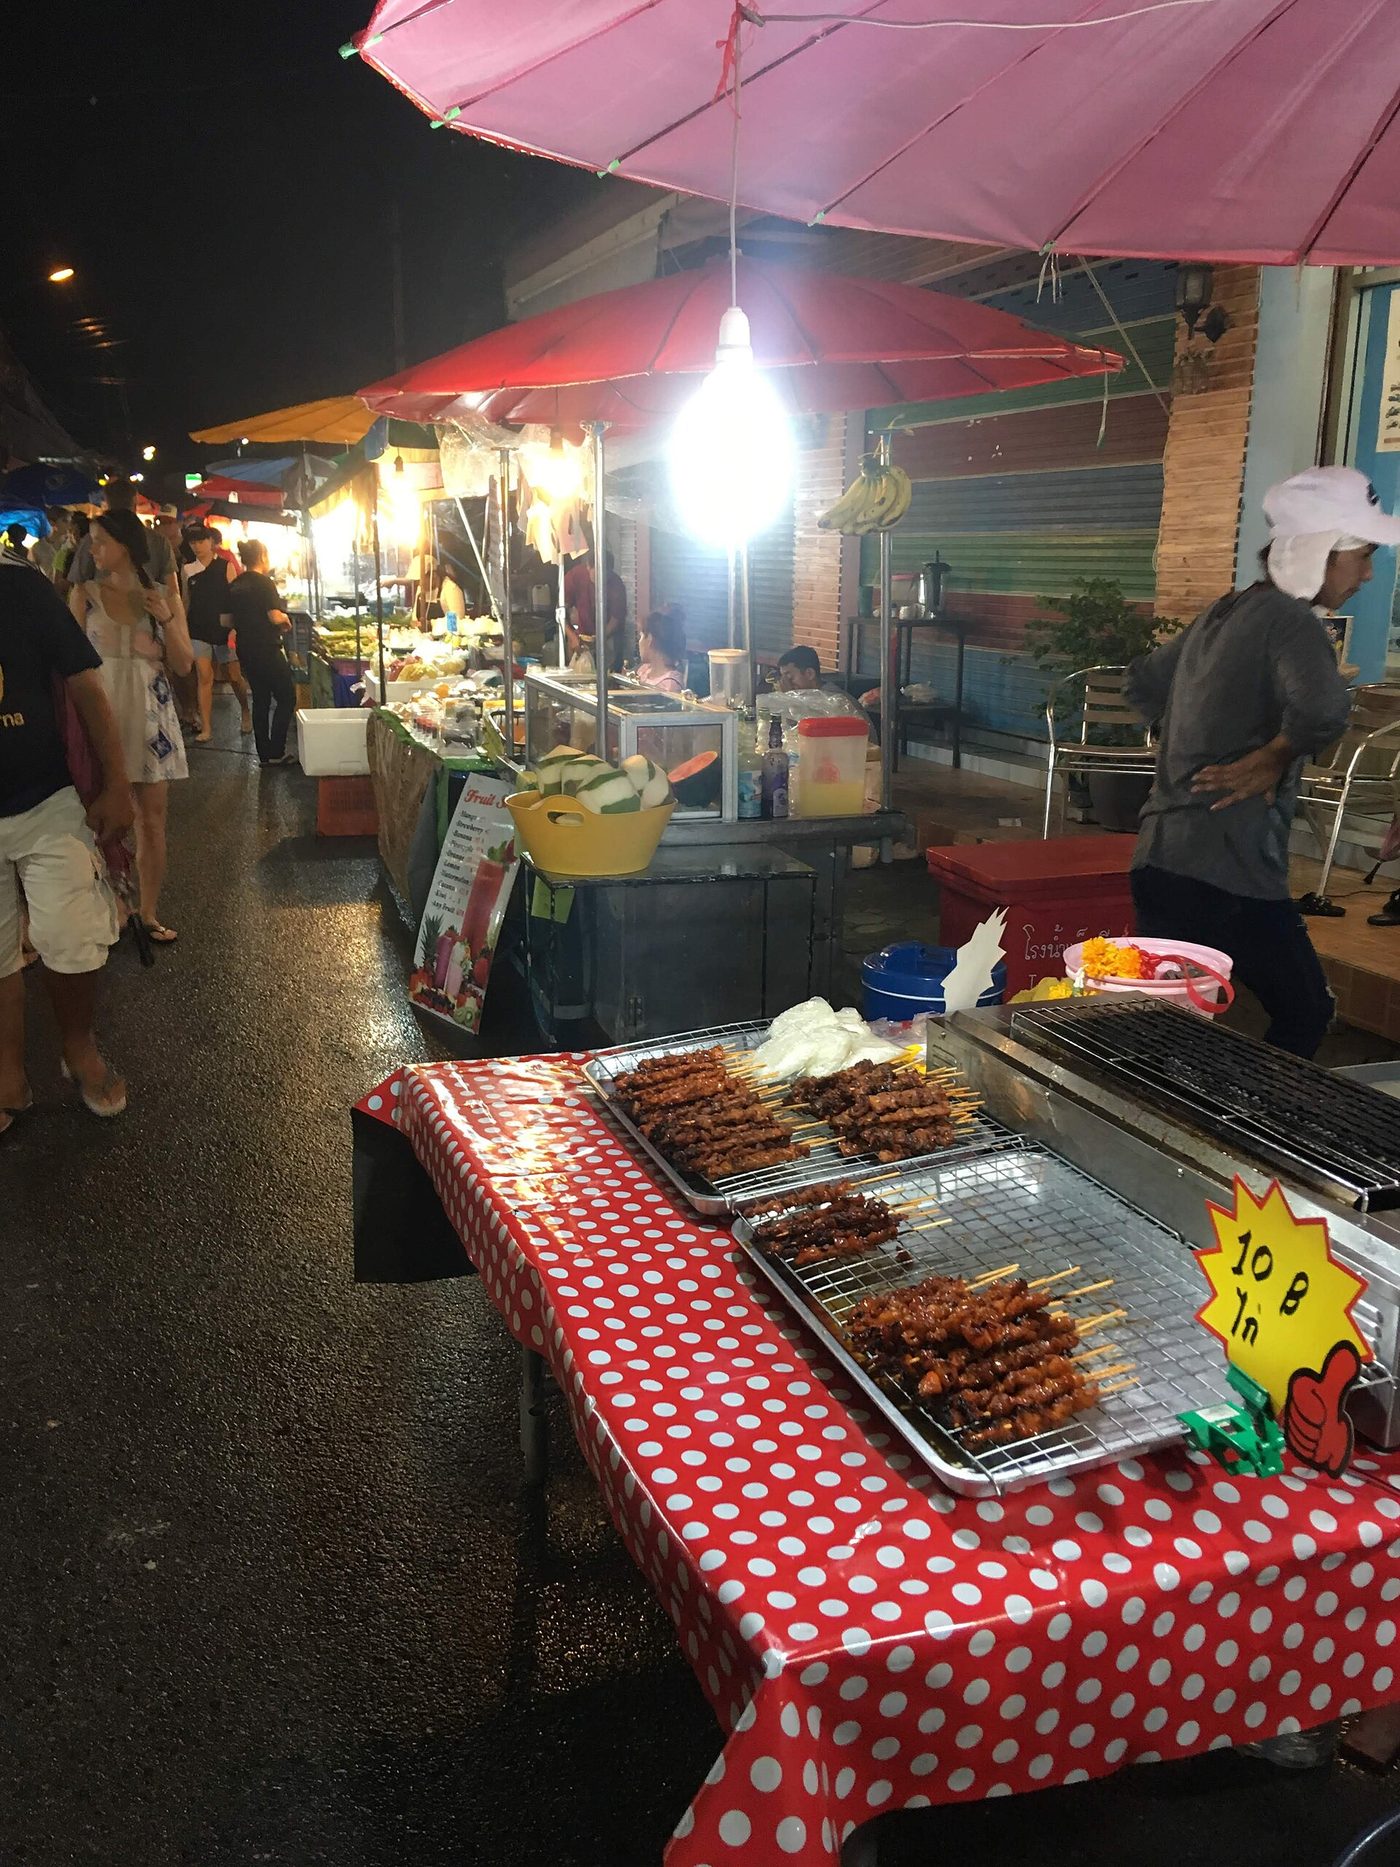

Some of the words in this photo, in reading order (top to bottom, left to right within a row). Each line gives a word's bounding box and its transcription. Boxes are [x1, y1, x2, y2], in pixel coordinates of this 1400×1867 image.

[464, 789, 496, 805] Fruit
[456, 821, 483, 833] Strawberry
[453, 831, 472, 841] Banana
[444, 861, 460, 870] Lemon
[441, 870, 469, 885] Watermelon
[435, 890, 446, 899] Kiwi
[442, 903, 455, 913] Fruit
[1231, 1229, 1274, 1282] 10
[1279, 1271, 1310, 1316] B
